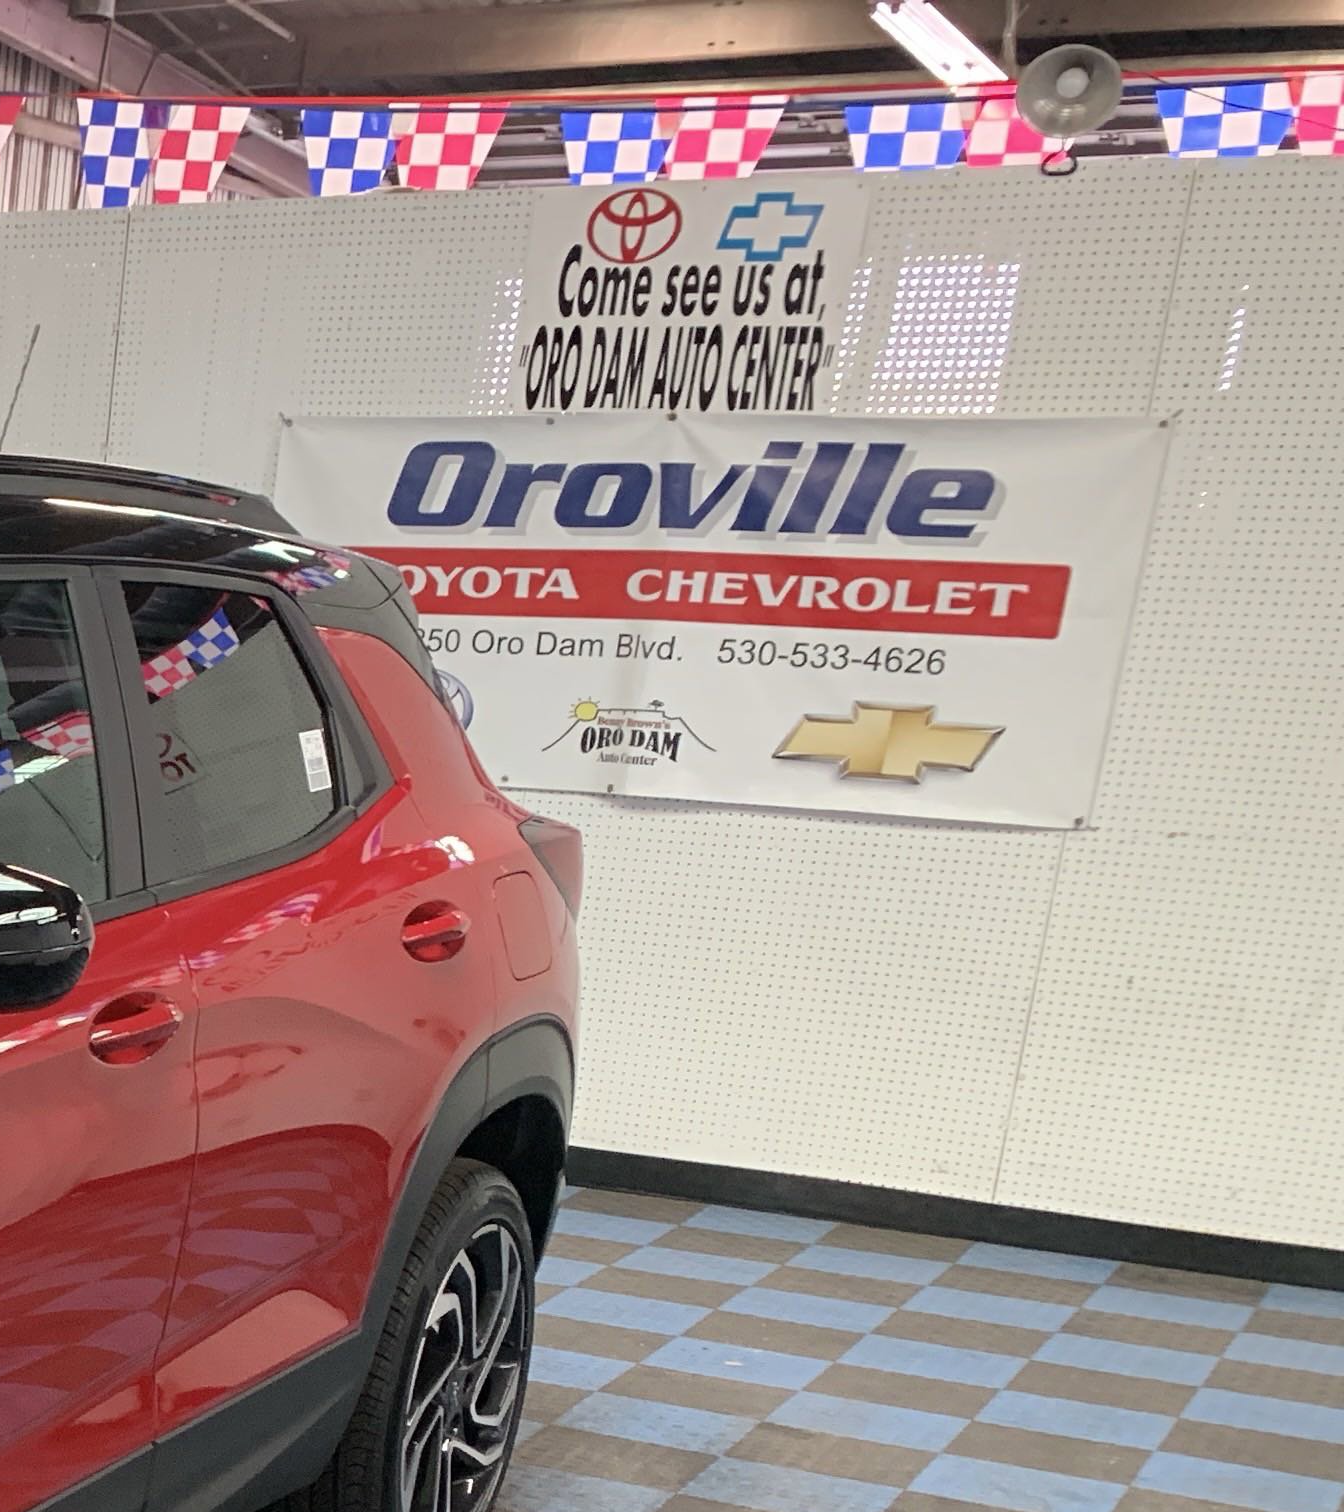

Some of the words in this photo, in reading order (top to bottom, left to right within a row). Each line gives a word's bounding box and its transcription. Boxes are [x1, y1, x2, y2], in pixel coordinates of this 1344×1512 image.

[558, 244, 652, 318] Come
[661, 264, 722, 317] see
[733, 263, 774, 316] us
[784, 249, 826, 321] at,
[518, 325, 583, 411] "ORO
[583, 326, 650, 409] DAM
[648, 324, 724, 412] AUTO
[726, 325, 836, 412] CENTER"
[386, 440, 996, 540] Oroville
[398, 565, 580, 600] OYOTA
[626, 568, 1030, 618] CHEVROLET
[472, 629, 524, 656] Oro
[536, 632, 604, 658] Dam
[615, 633, 683, 661] Blvd.
[717, 639, 947, 676] 530-533-4626
[580, 726, 624, 754] ORO
[629, 729, 682, 762] DAM
[597, 751, 618, 765] Auto
[620, 753, 657, 766] Center
